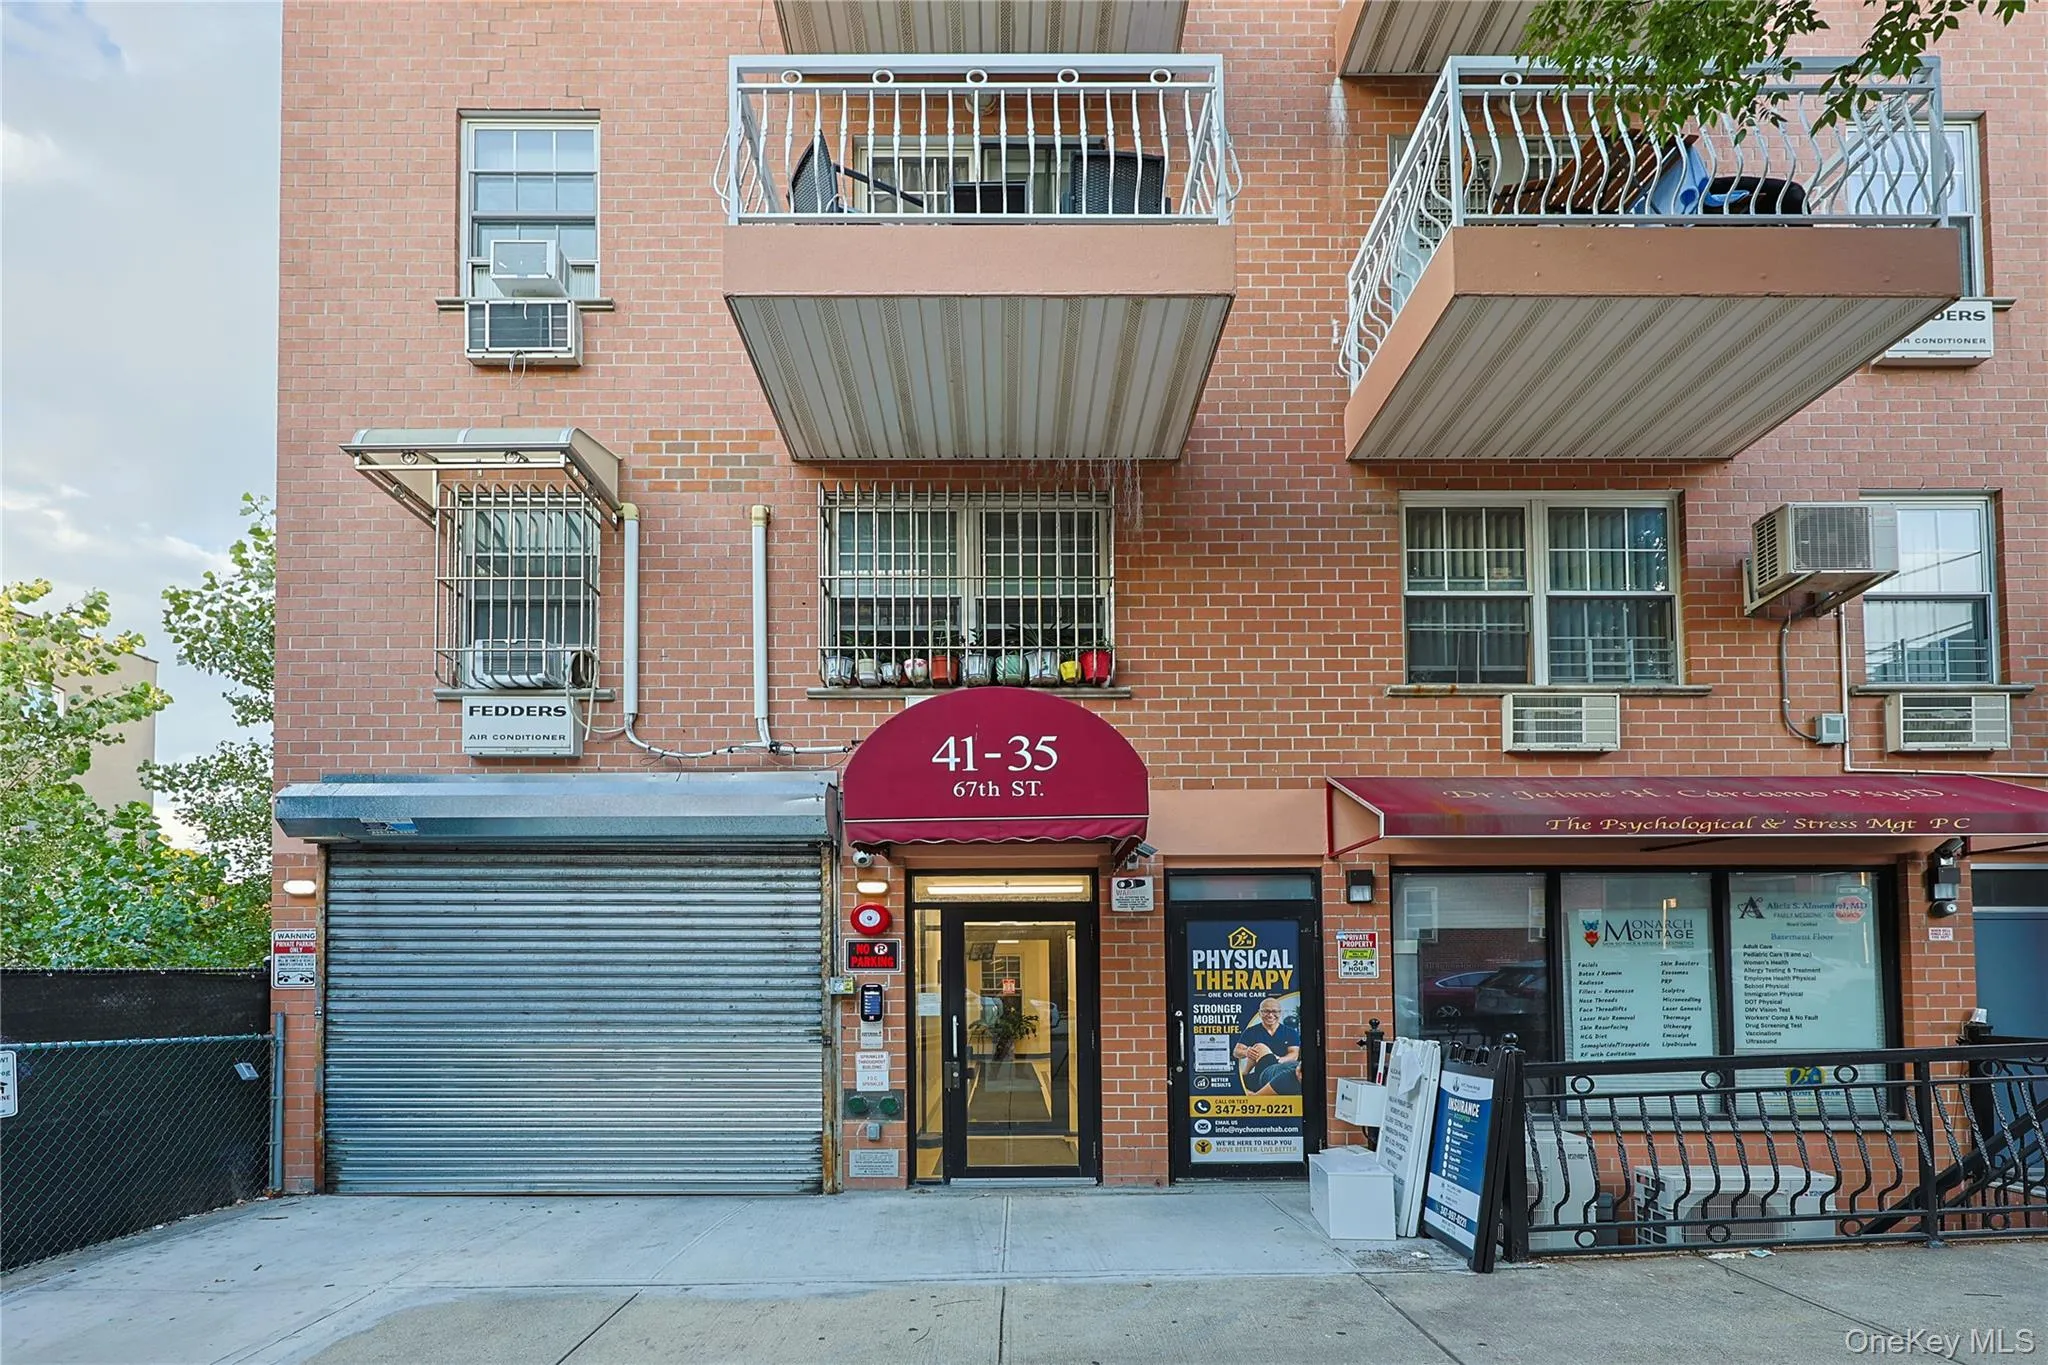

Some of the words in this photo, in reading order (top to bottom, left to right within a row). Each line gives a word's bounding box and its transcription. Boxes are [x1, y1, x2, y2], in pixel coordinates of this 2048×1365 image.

[469, 706, 566, 716] FEDDERS
[932, 735, 1058, 772] 41-35
[953, 780, 1000, 797] 67th
[1012, 780, 1044, 797] ST.
[1443, 790, 1505, 798] Dr.
[1513, 790, 1616, 800] Jaime
[1678, 789, 1828, 798] Carcamo
[1546, 817, 1591, 830] The
[1600, 816, 1757, 834] Psychological
[1762, 818, 1786, 829] &
[1793, 818, 1857, 829] Stress
[1866, 818, 1916, 833] Mgt
[856, 944, 870, 955] NO
[850, 956, 894, 967] PARKING
[1193, 949, 1293, 969] PHYSICAL
[1193, 970, 1293, 990] THERAPY
[1193, 1004, 1242, 1014] STRONGER
[1194, 1015, 1239, 1024] MOBILITY.
[1194, 1025, 1222, 1034] BETTER
[1224, 1025, 1241, 1034] LIFE.
[1215, 1105, 1293, 1114] 347-997-0221
[1448, 1097, 1480, 1118] INSURANCE
[1215, 1126, 1298, 1134] info@nychomerehab.com
